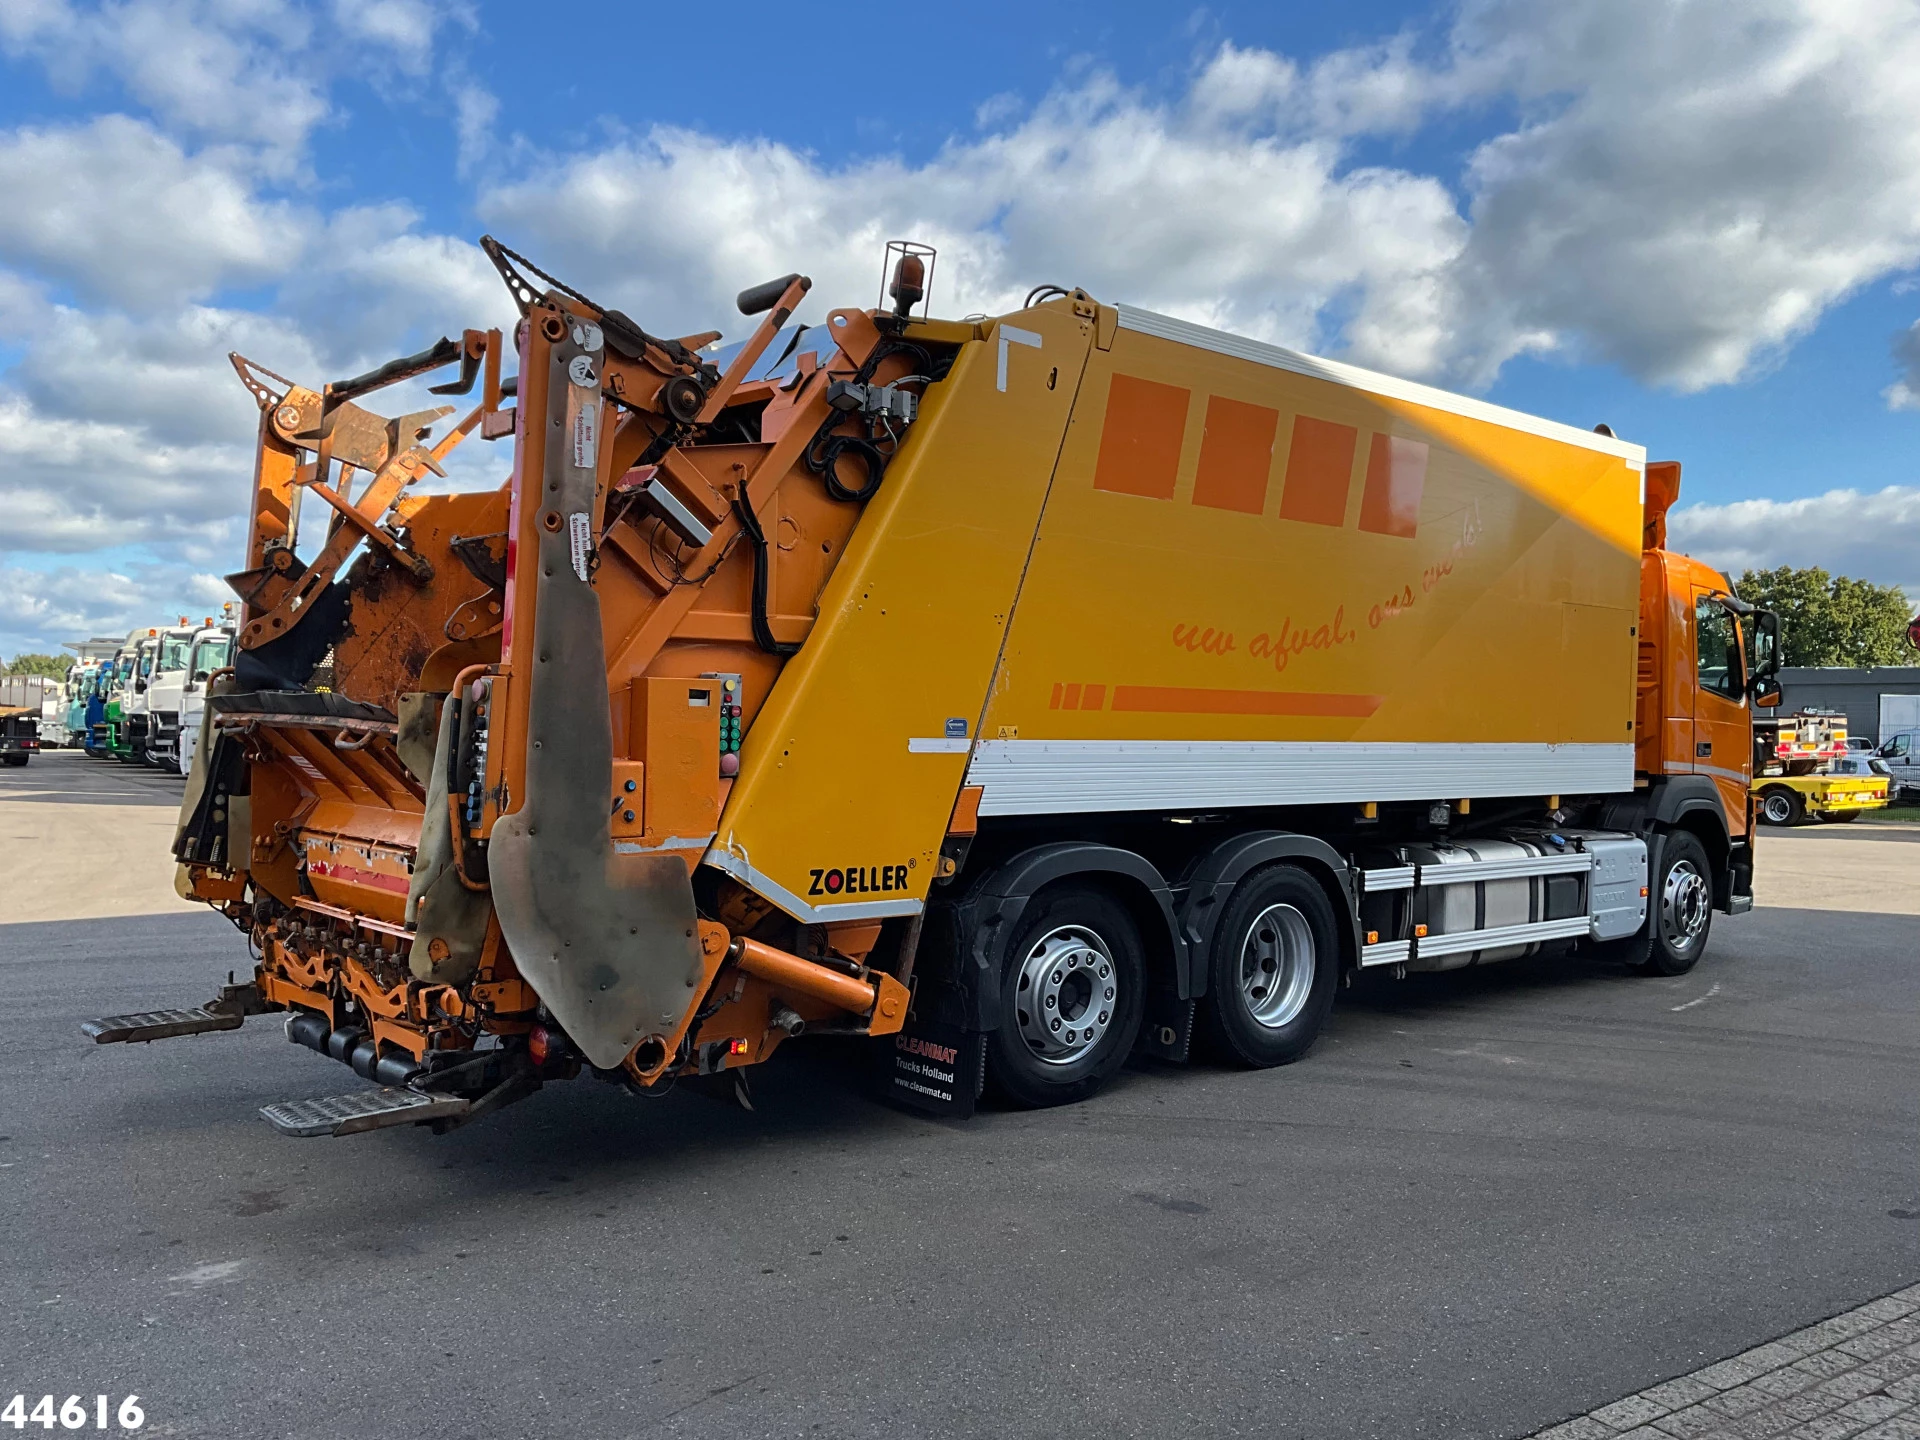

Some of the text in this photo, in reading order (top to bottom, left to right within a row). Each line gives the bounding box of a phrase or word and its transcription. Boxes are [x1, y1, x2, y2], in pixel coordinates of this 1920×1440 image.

[572, 517, 580, 556] Schwenkarm
[1249, 604, 1356, 672] afval,
[1368, 584, 1416, 629] ons
[808, 864, 908, 896] ZOELLER
[895, 1034, 958, 1065] CLEANMAT
[896, 1056, 954, 1084] Trucks Holland
[894, 1076, 952, 1101] www.cleanmat.eu
